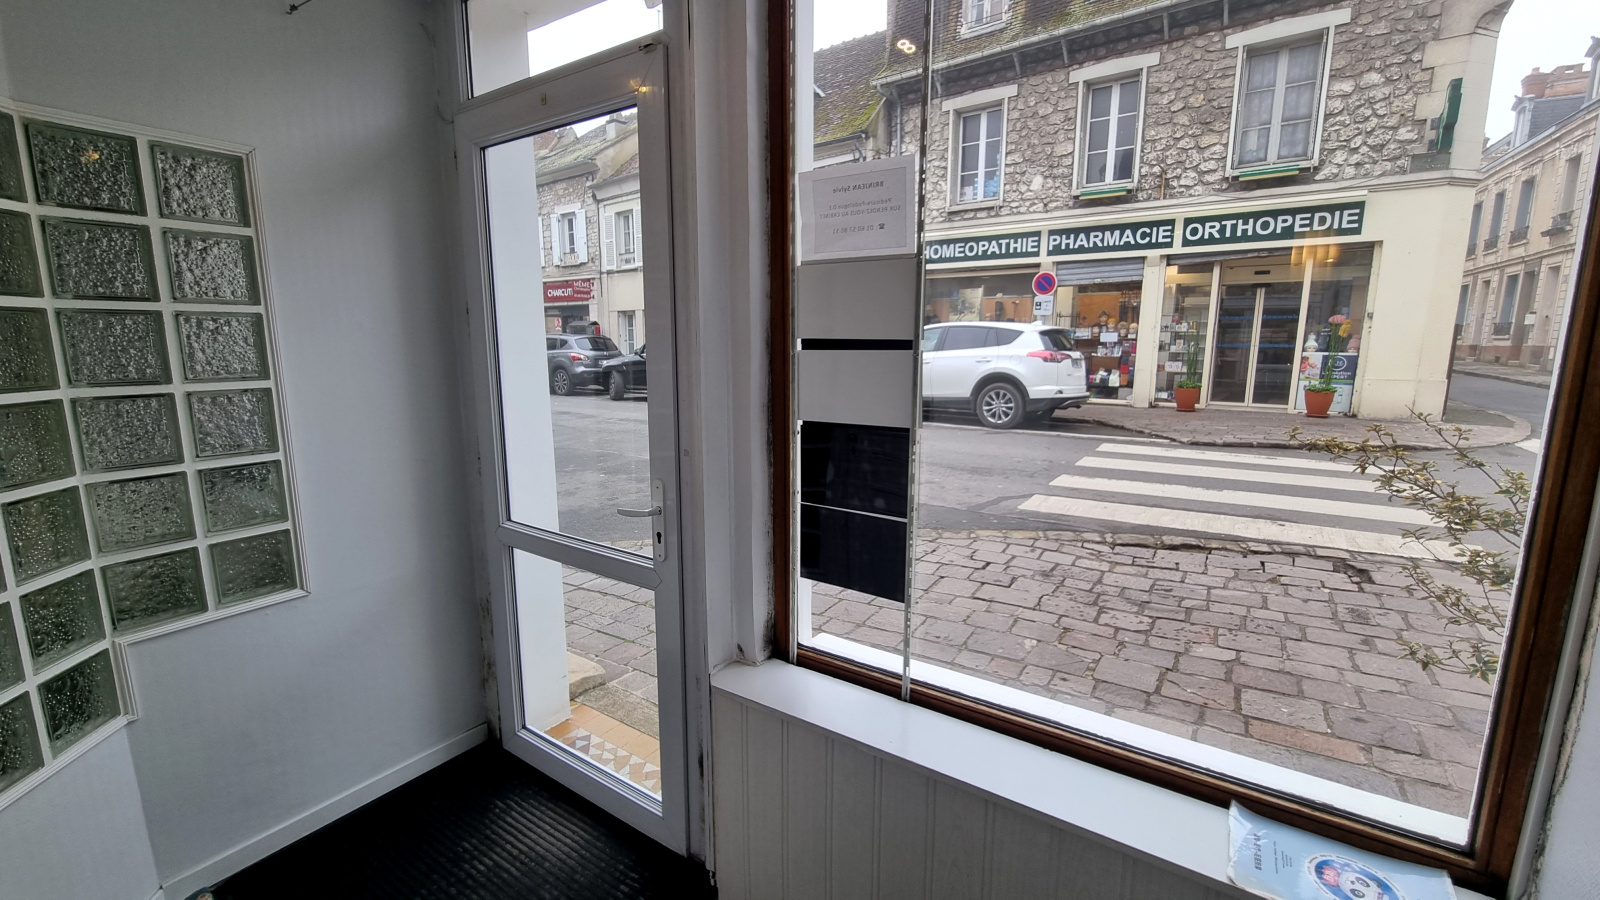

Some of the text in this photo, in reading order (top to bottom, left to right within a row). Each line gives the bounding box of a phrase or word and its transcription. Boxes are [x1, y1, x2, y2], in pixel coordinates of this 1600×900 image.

[1048, 225, 1173, 251] PHARMACIE
[1185, 208, 1361, 242] ORTHOPEDIE
[924, 236, 1039, 260] HOMEOPATHIE
